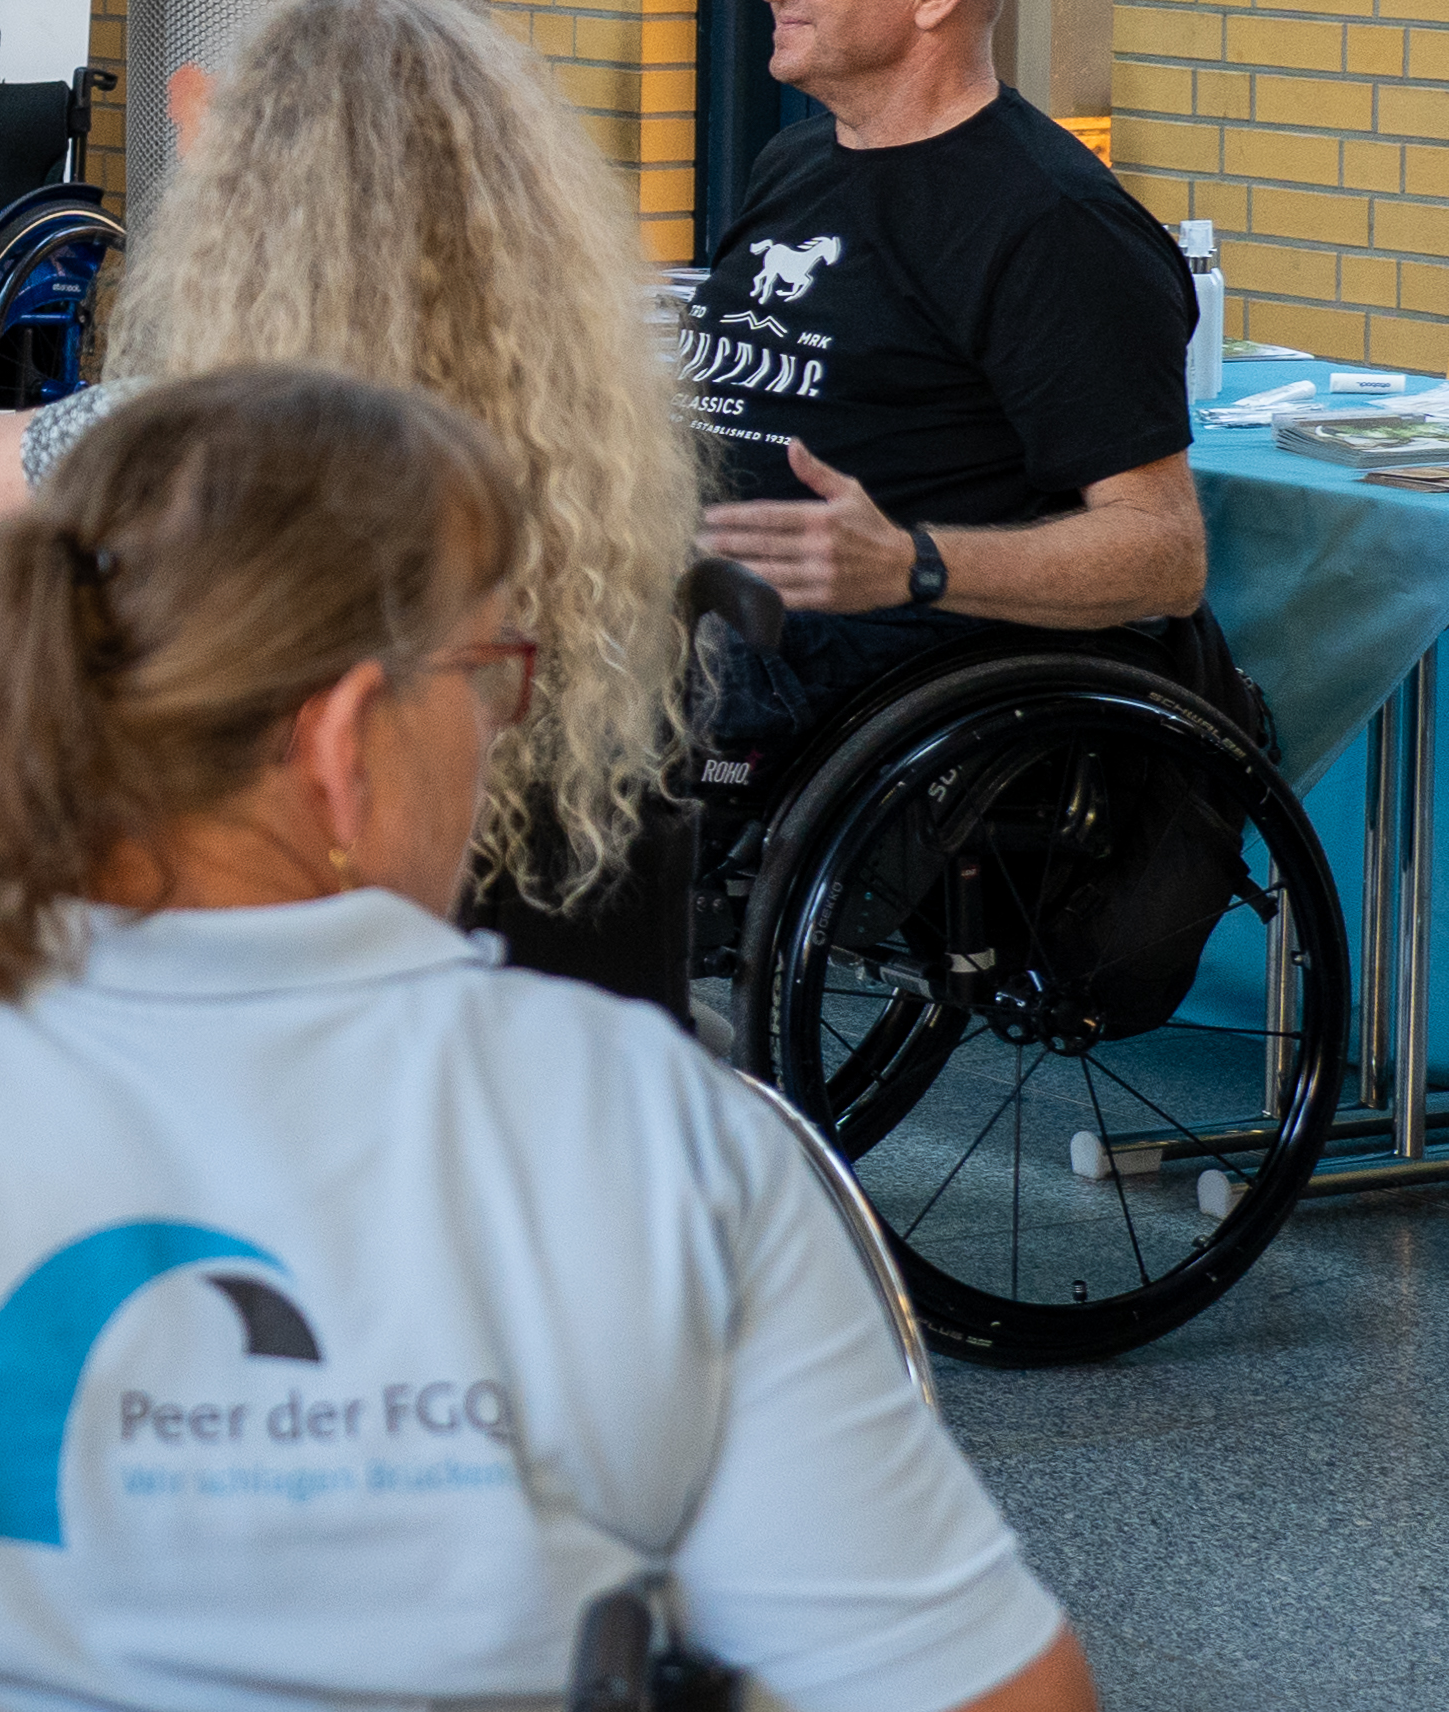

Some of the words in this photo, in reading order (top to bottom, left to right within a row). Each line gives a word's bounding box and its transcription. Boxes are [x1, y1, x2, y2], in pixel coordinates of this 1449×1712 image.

[797, 332, 832, 349] MRK
[690, 420, 761, 440] ESTABLISHED
[765, 434, 792, 446] 1932
[121, 1390, 247, 1443] Peer
[267, 1389, 361, 1443] der
[383, 1379, 514, 1443] FGQ
